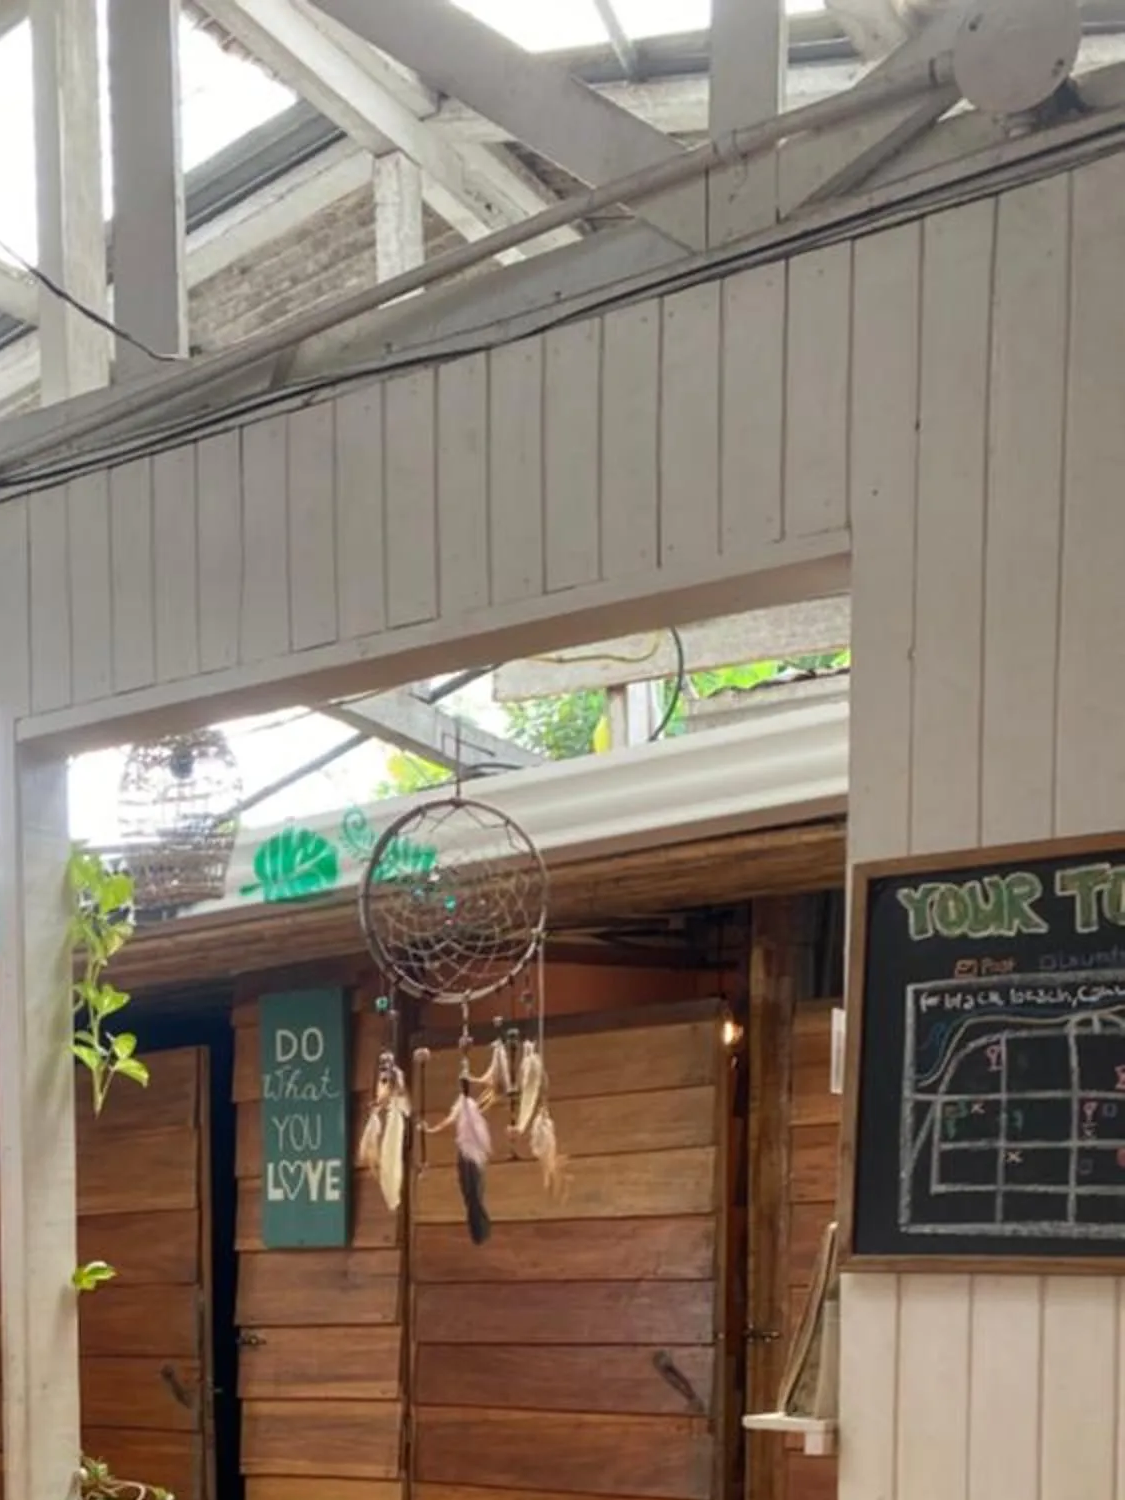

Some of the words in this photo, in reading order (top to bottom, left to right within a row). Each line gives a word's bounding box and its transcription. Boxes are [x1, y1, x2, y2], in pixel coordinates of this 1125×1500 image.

[897, 870, 1049, 940] YOUR
[276, 1027, 324, 1062] DO
[271, 1112, 322, 1152] YOU
